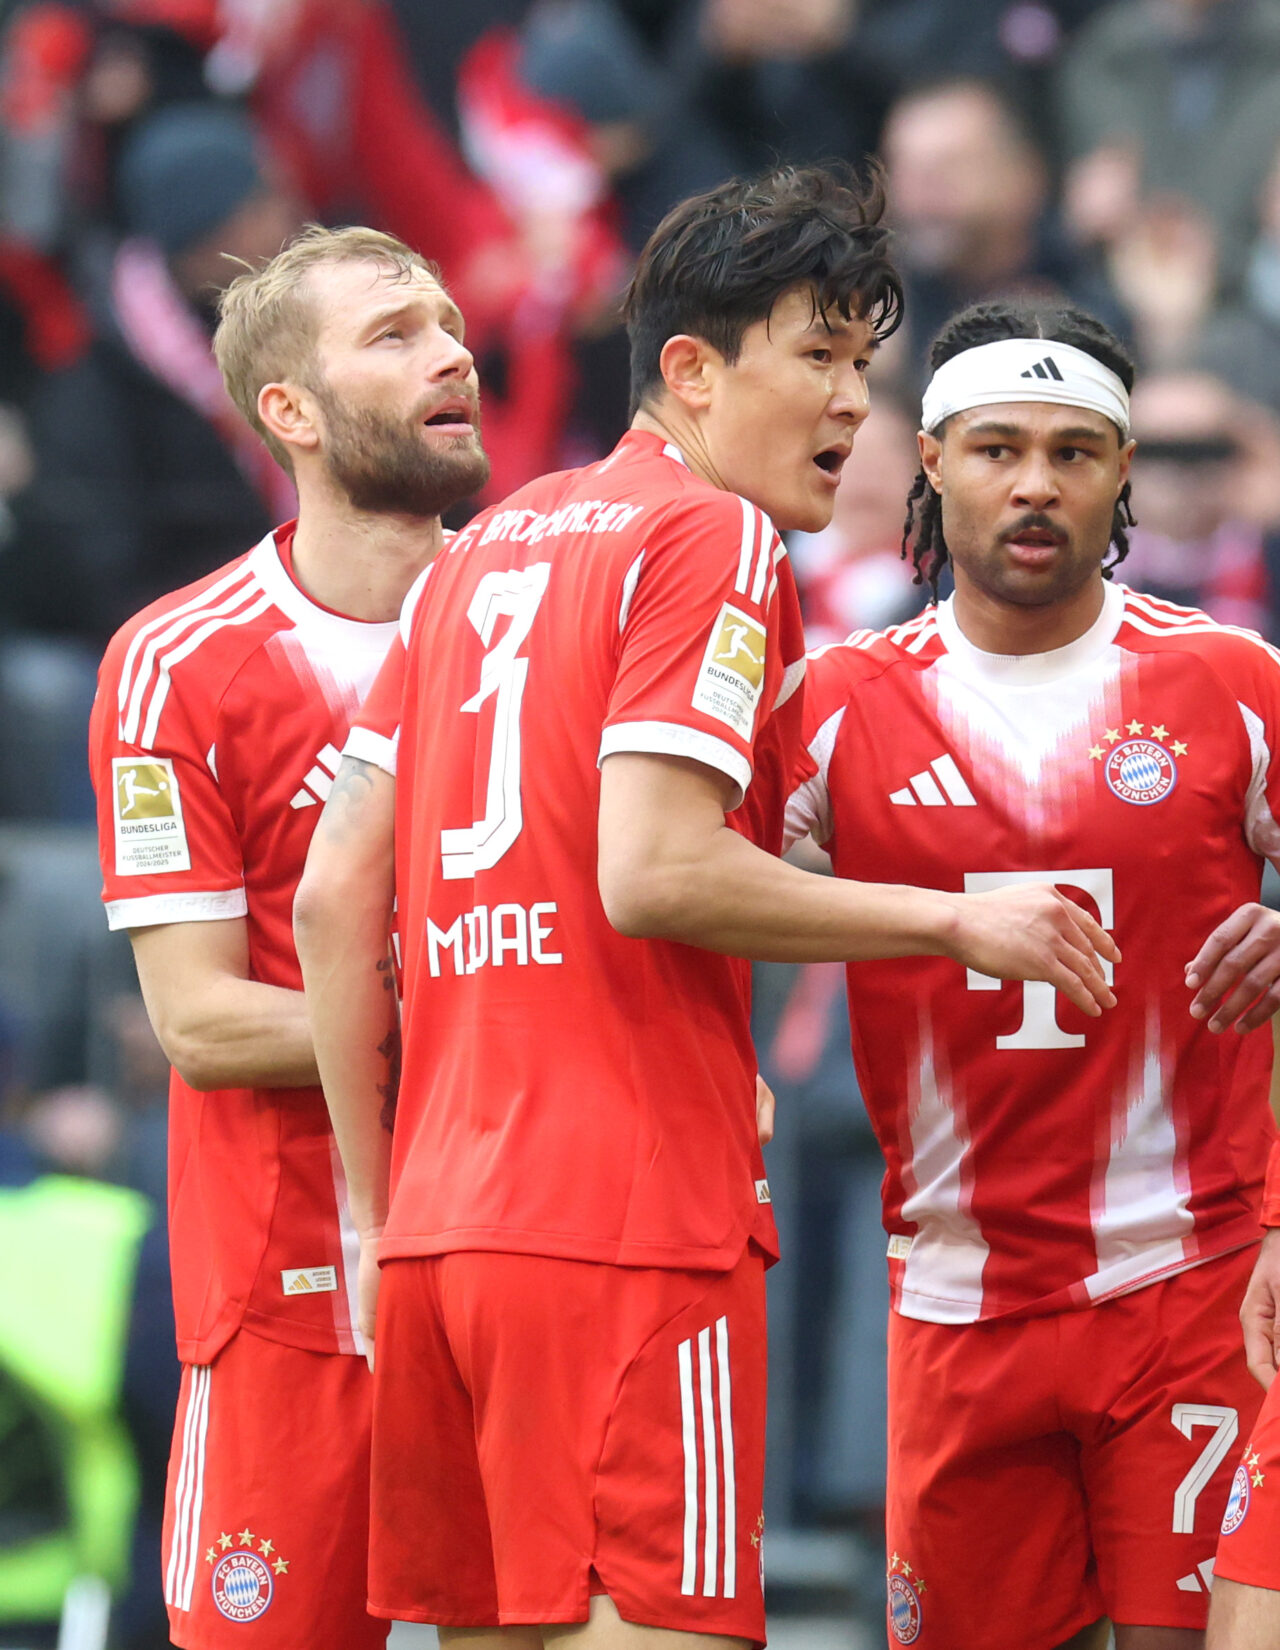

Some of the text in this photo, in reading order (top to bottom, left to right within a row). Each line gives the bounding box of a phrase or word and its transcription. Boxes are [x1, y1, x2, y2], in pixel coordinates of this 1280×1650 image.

[449, 523, 481, 553] F
[707, 666, 754, 702] BUNDESLIGA
[1110, 744, 1169, 769] FC BAYERN
[120, 822, 178, 834] BUNDESLIGA
[132, 845, 169, 854] DEUTSCHER
[1170, 1402, 1239, 1534] 7
[217, 1556, 268, 1585] FC BAYERN
